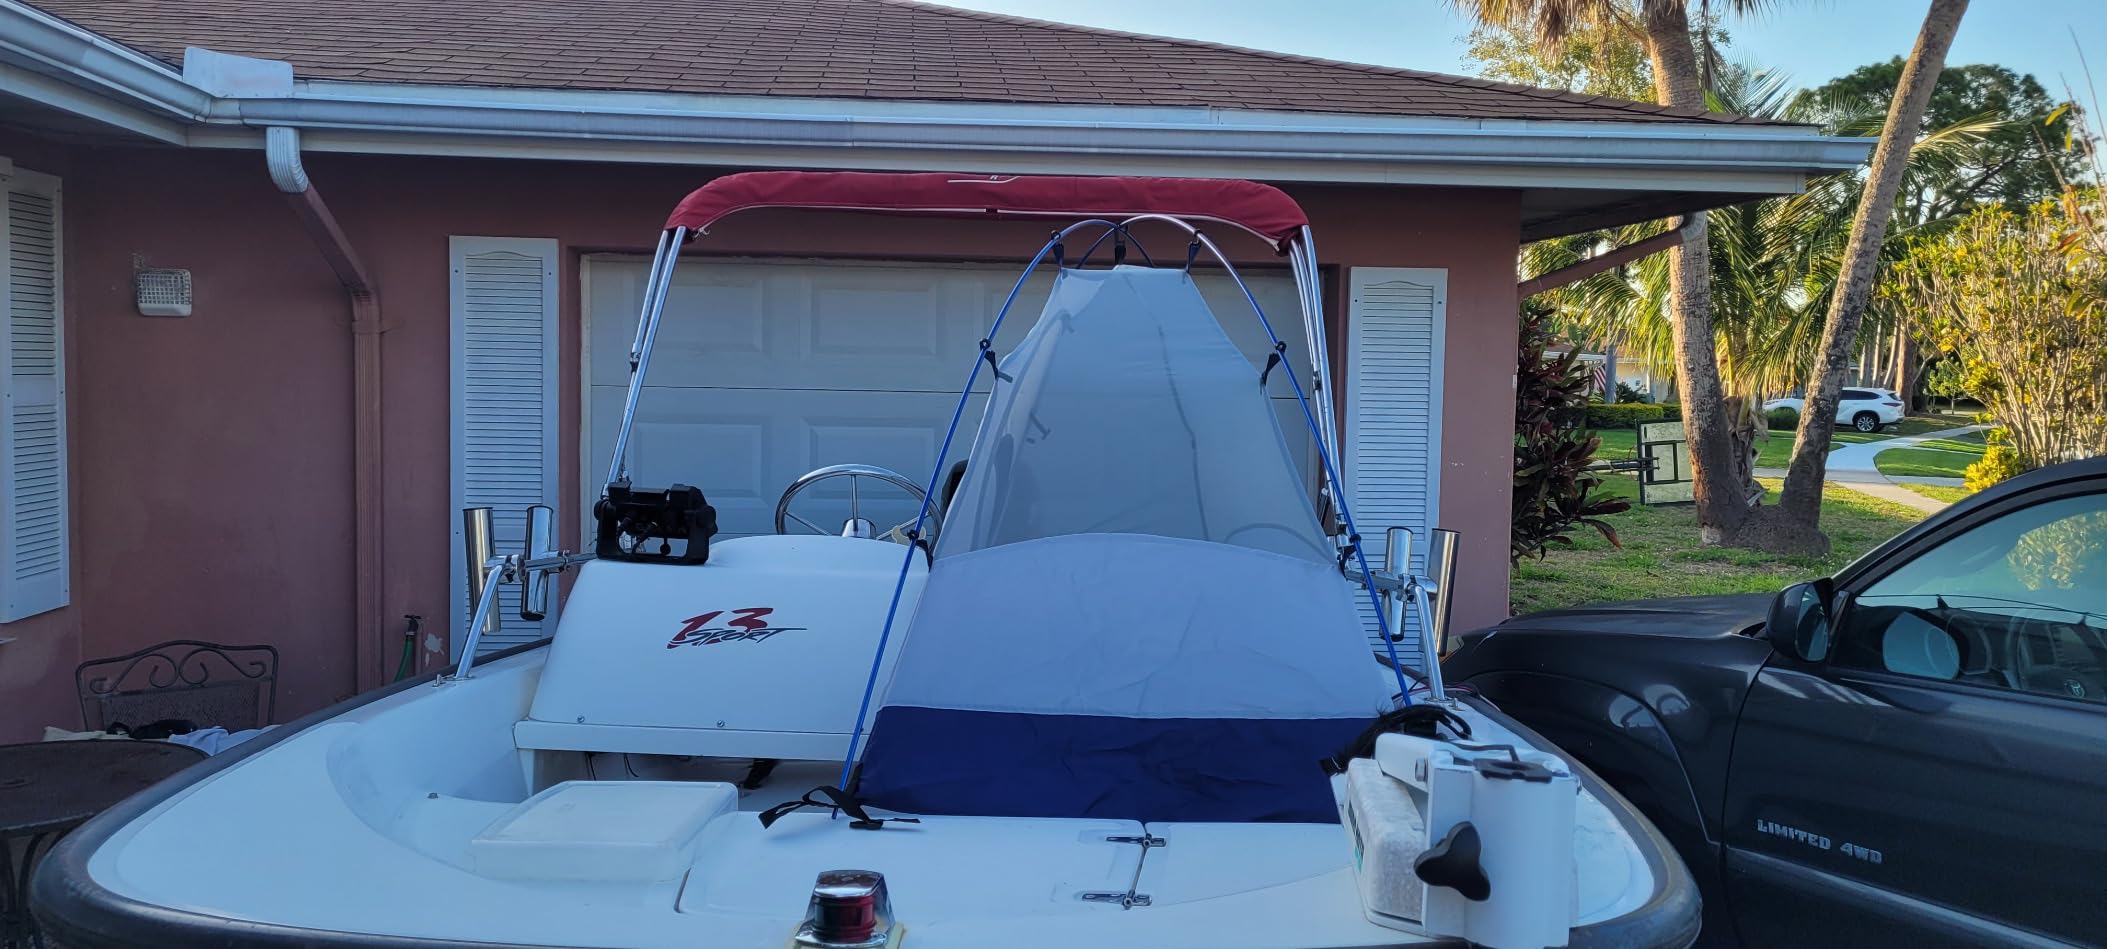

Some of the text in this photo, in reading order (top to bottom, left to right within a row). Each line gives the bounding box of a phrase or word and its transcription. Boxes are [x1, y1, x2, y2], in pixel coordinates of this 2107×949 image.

[667, 607, 774, 649] 13
[670, 627, 808, 646] SPORT
[1757, 819, 1883, 865] LIMITED 4WD
